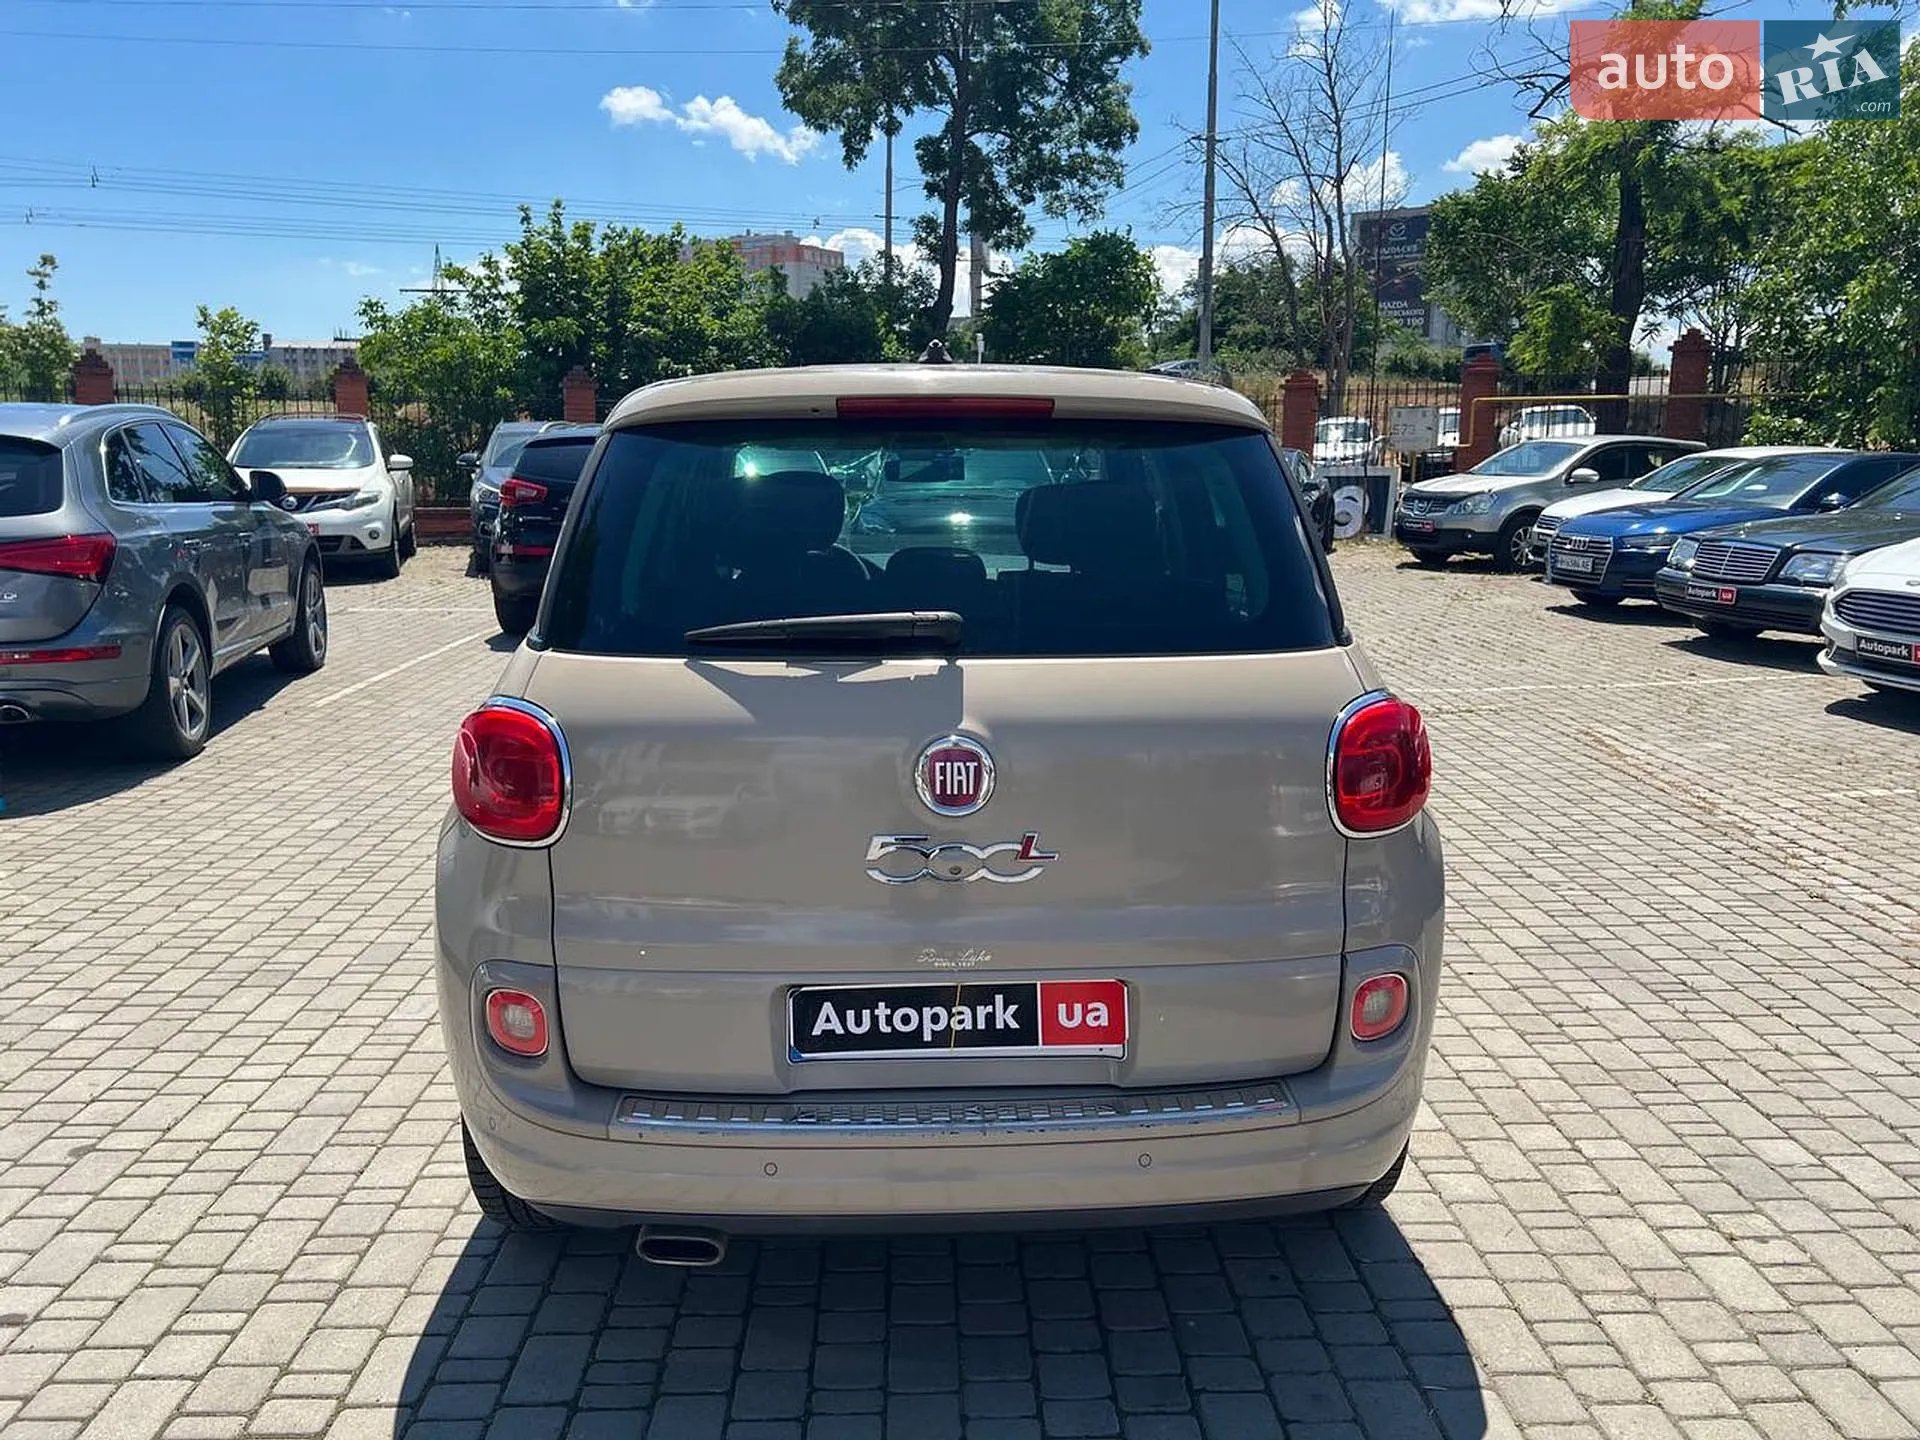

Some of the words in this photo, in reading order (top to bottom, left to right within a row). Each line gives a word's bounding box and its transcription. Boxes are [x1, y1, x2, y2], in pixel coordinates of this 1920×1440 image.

[1688, 586, 1717, 599] Autopark
[1722, 591, 1733, 600] ua
[1859, 638, 1909, 656] Autopark
[933, 761, 979, 796] FIAT
[811, 994, 1020, 1041] Autopark
[1057, 1001, 1109, 1028] ua
